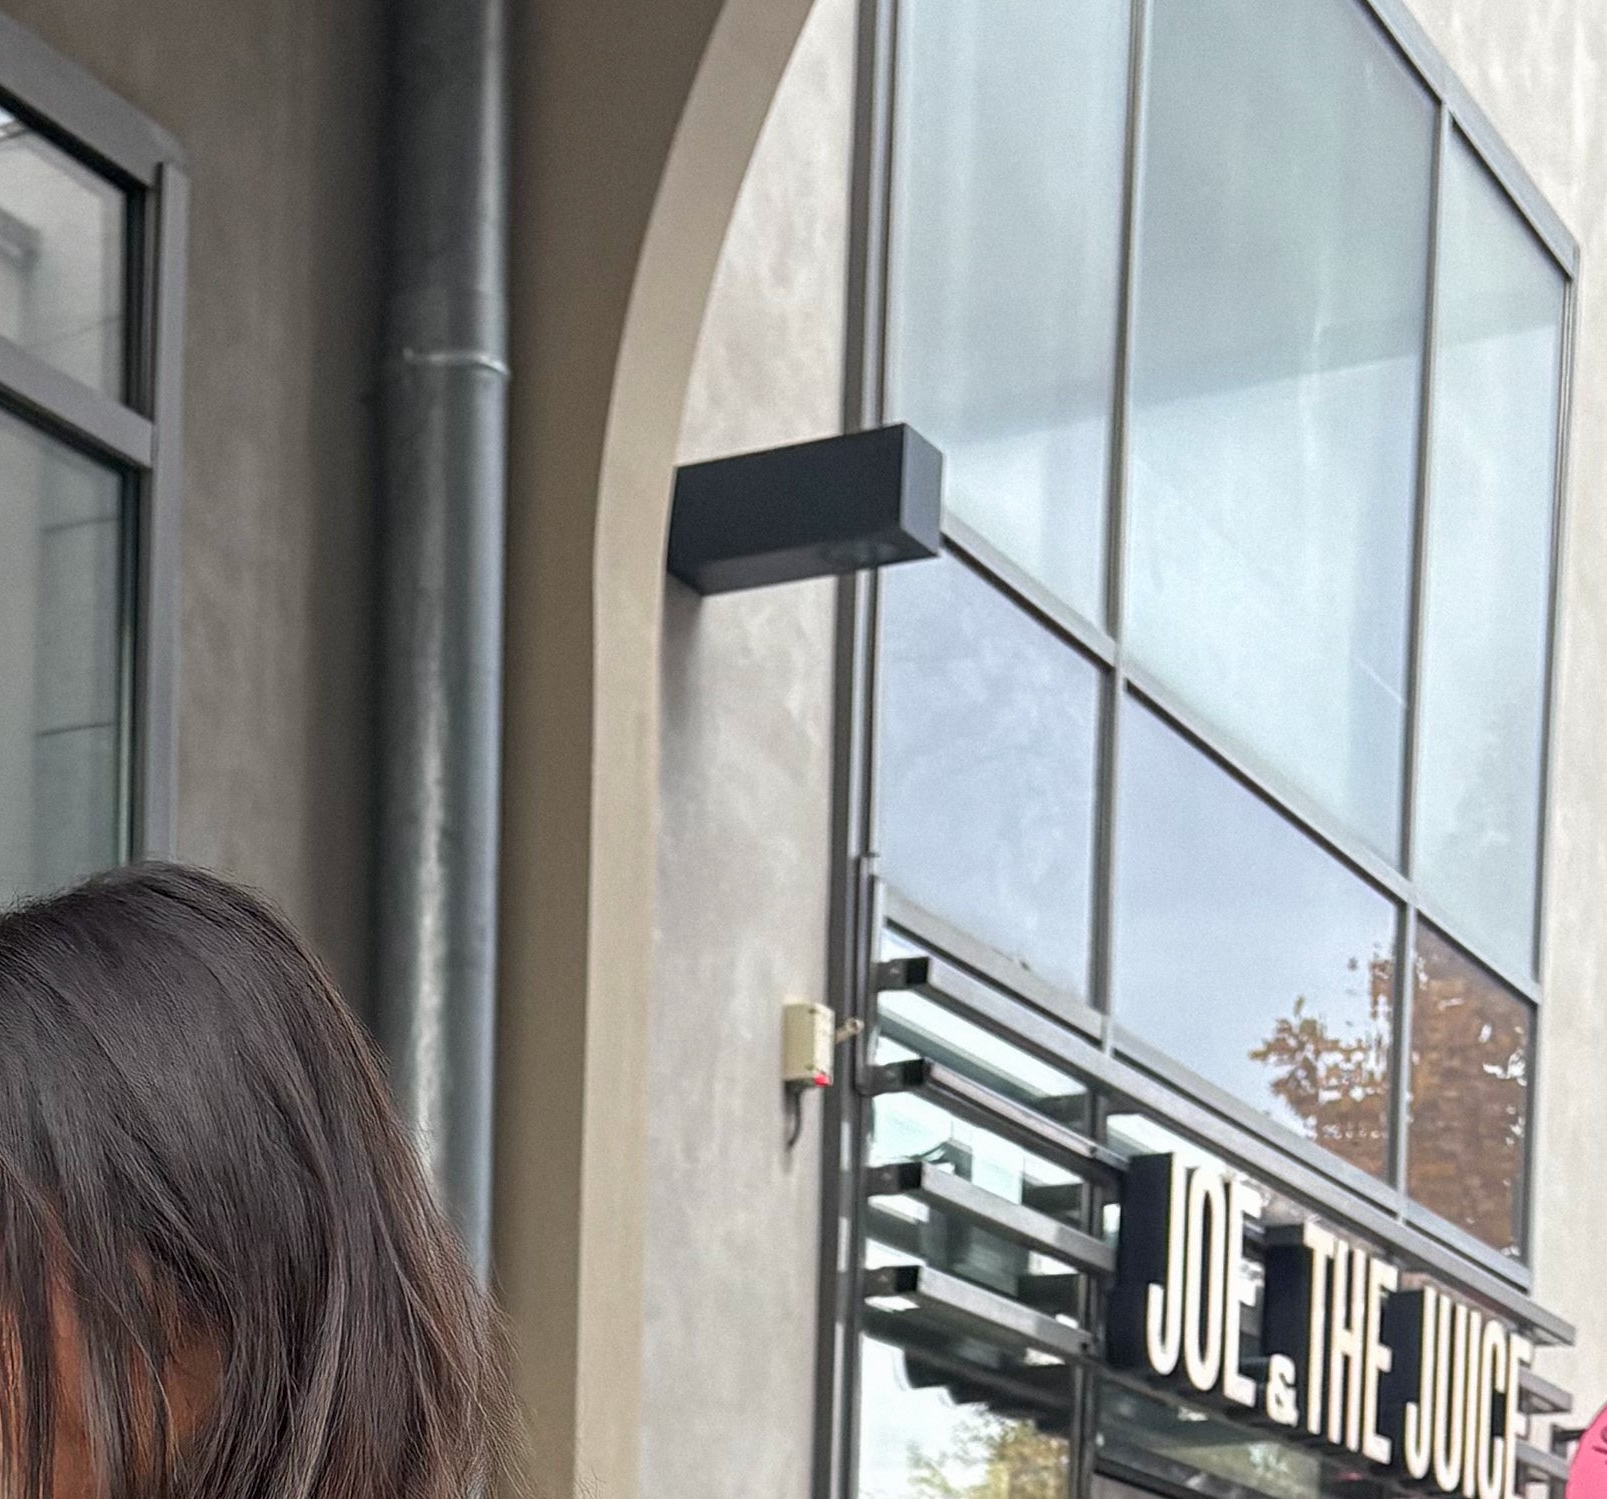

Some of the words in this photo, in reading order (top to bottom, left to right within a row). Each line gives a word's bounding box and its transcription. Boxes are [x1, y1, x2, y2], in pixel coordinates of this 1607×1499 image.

[1146, 1151, 1263, 1408] JOE
[1266, 1354, 1299, 1427] &
[1304, 1221, 1399, 1466] THE
